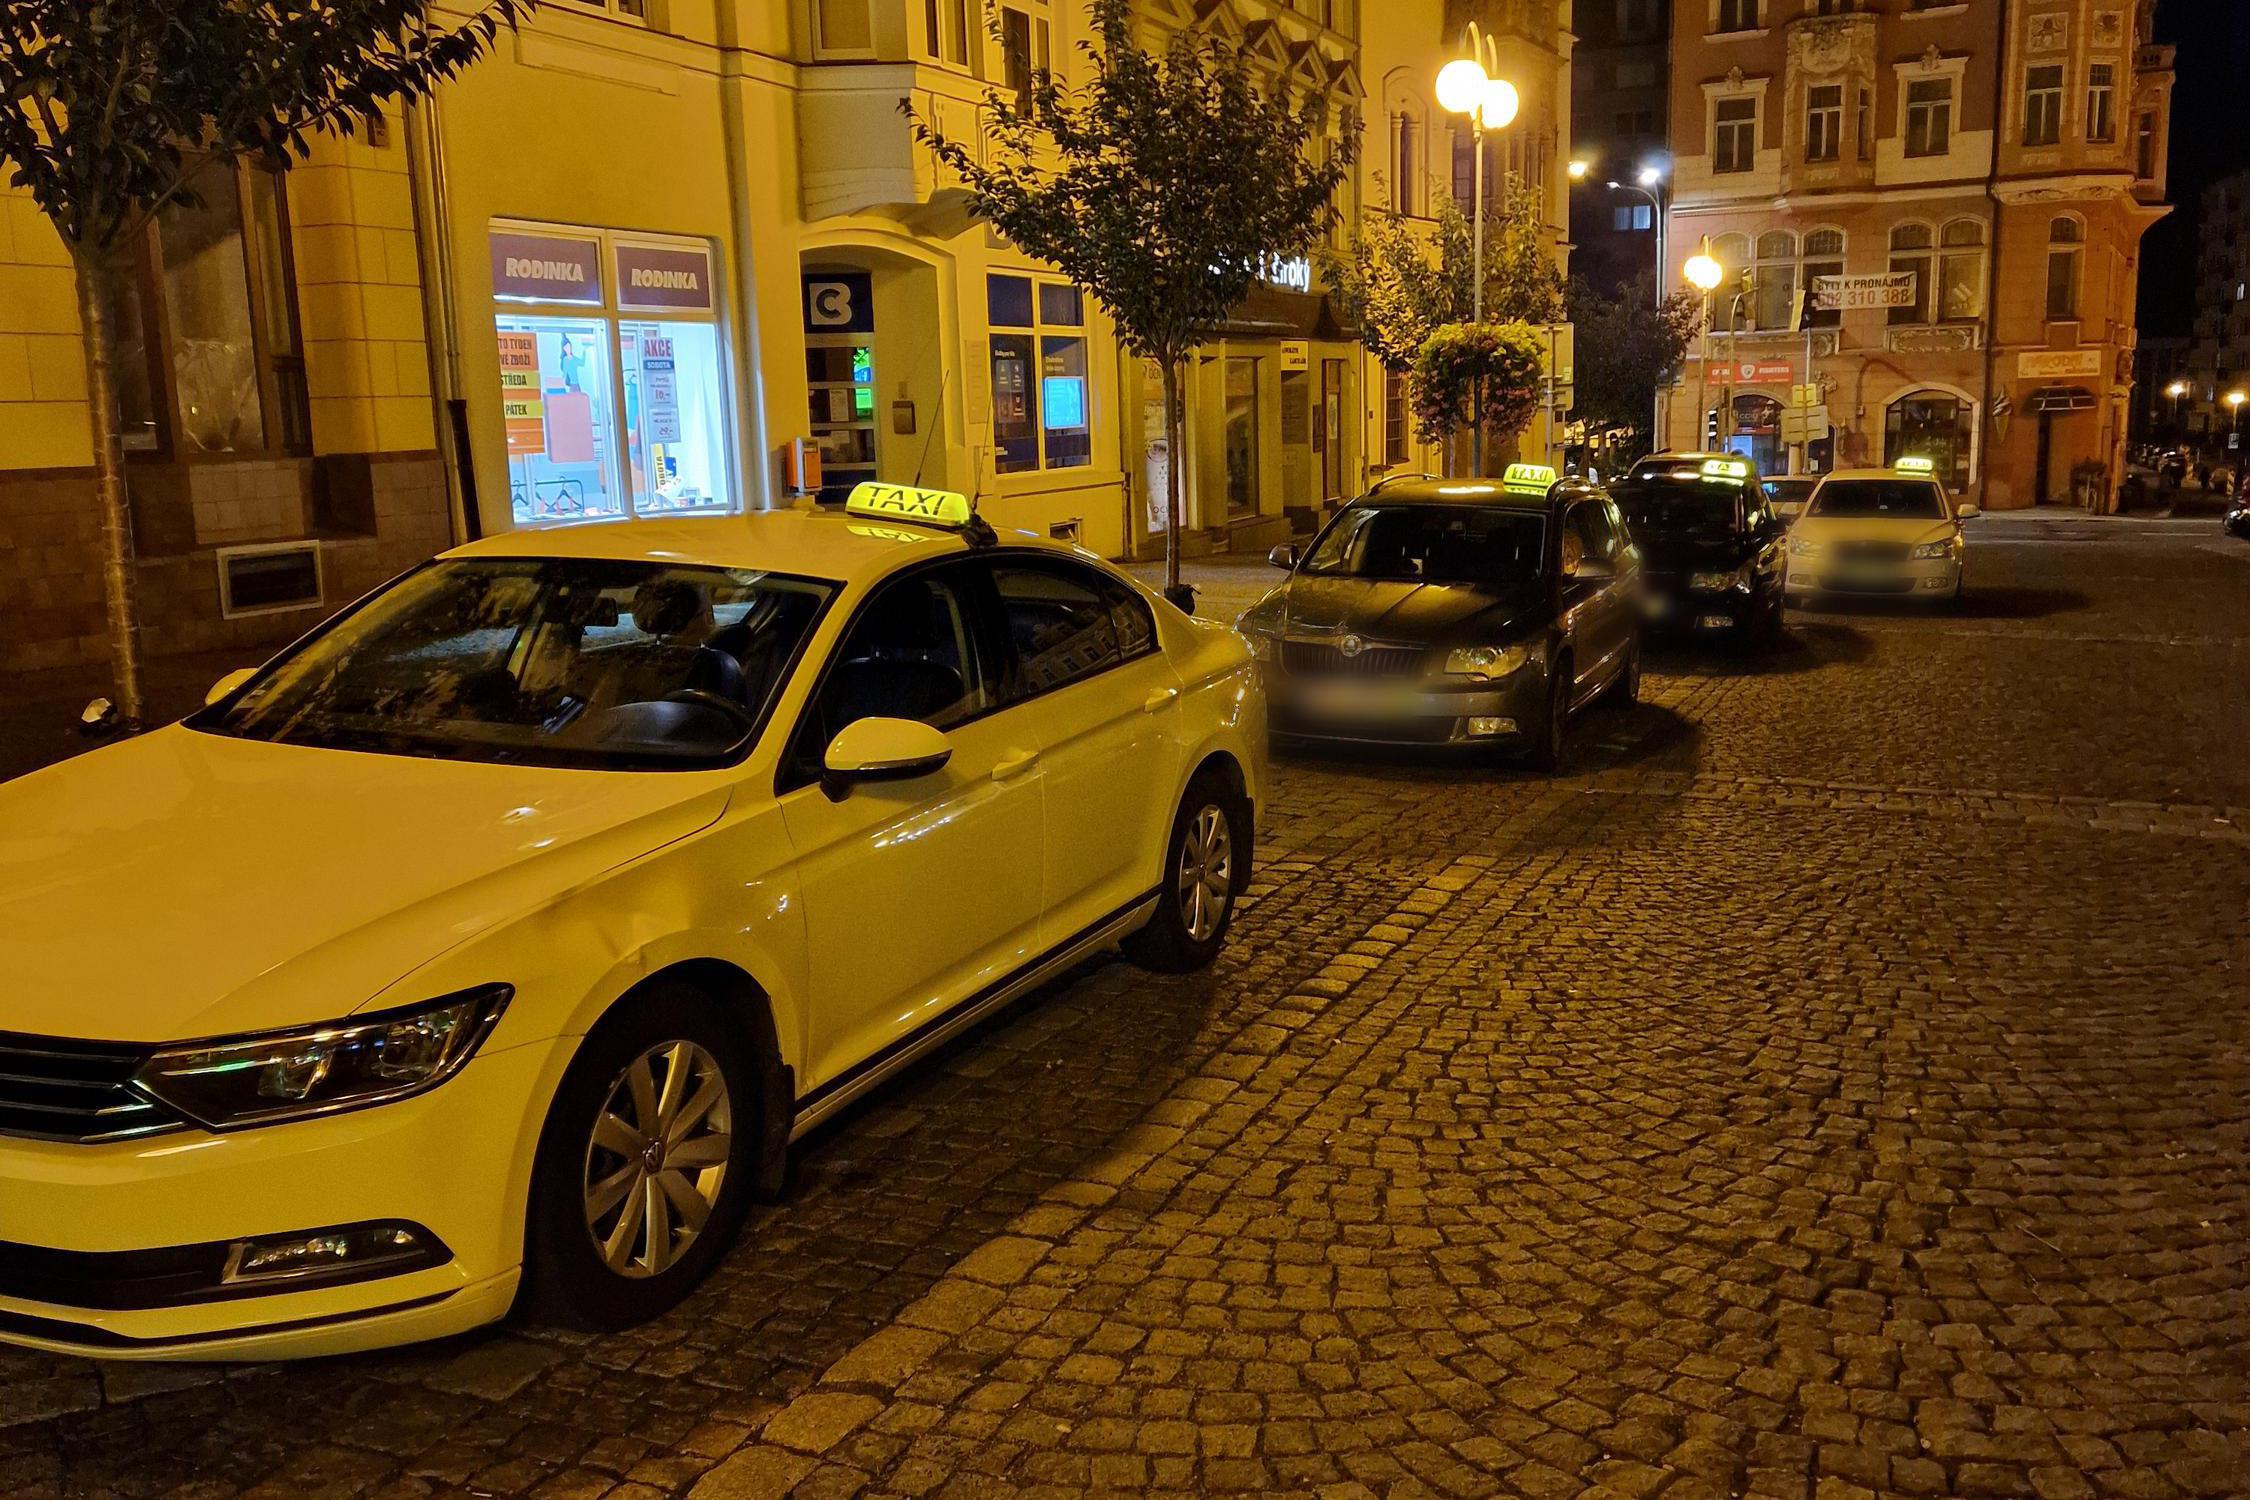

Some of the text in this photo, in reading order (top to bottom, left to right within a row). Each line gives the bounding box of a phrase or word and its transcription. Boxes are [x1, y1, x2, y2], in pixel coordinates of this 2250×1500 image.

[505, 257, 584, 282] RODINKA
[631, 268, 698, 290] RODINKA
[1844, 280, 1851, 289] K
[1848, 291, 1876, 306] 310
[644, 339, 672, 357] AKCE
[506, 402, 527, 415] PÁTEK
[655, 455, 667, 486] OBOTA
[1510, 467, 1548, 482] TAXI
[868, 486, 946, 516] TAXI
